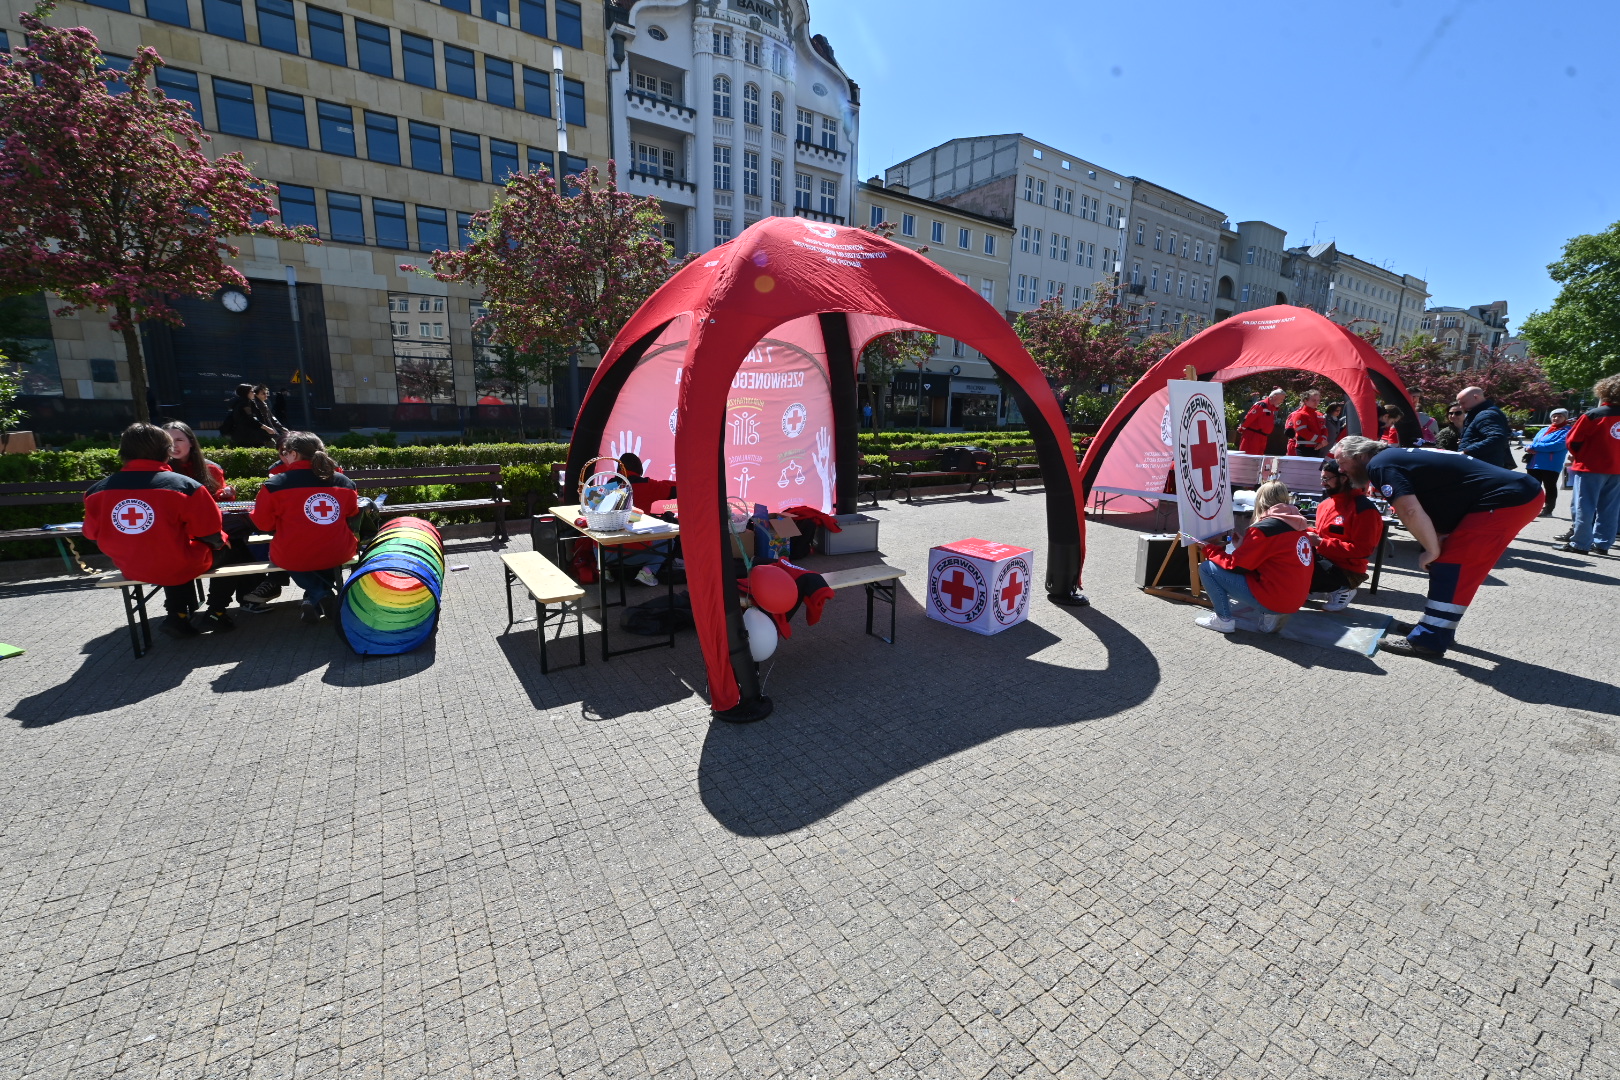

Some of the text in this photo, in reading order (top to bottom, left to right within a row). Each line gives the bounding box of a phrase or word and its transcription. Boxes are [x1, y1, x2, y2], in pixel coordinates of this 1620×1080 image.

[737, 0, 772, 20] BANK
[1183, 397, 1222, 434] CZERWONY
[1180, 443, 1202, 512] POLSKI
[114, 499, 152, 511] CZERWONY
[112, 512, 126, 532] POLSKI
[936, 558, 985, 587] CZERWONY
[999, 559, 1029, 583] CZERWONY
[931, 576, 947, 614] POLSKI
